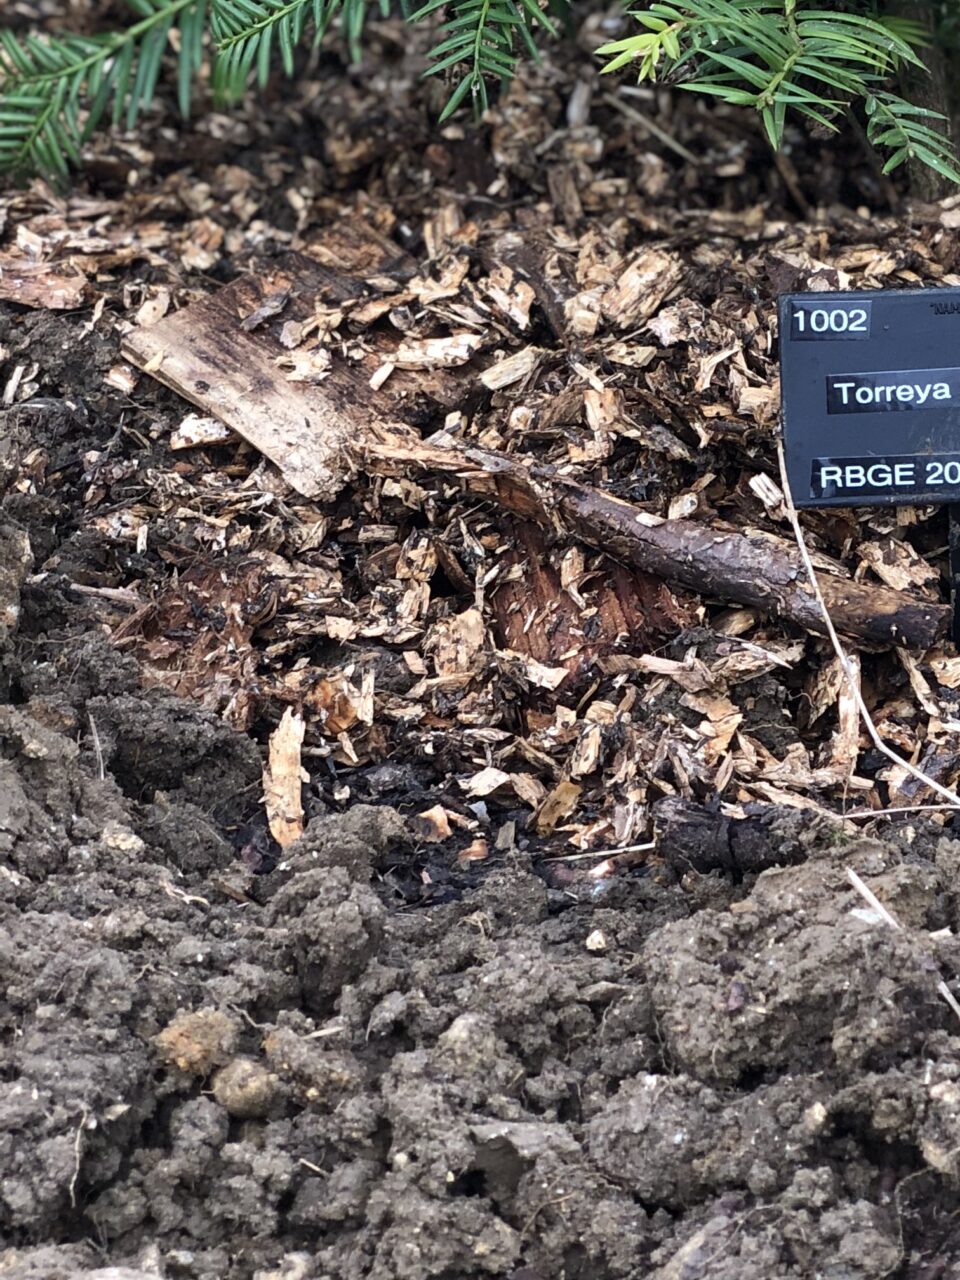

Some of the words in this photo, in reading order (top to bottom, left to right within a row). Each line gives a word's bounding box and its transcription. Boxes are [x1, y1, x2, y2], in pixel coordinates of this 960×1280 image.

[793, 309, 868, 332] 1002
[833, 380, 952, 407] Torreya
[820, 463, 915, 489] RBGE
